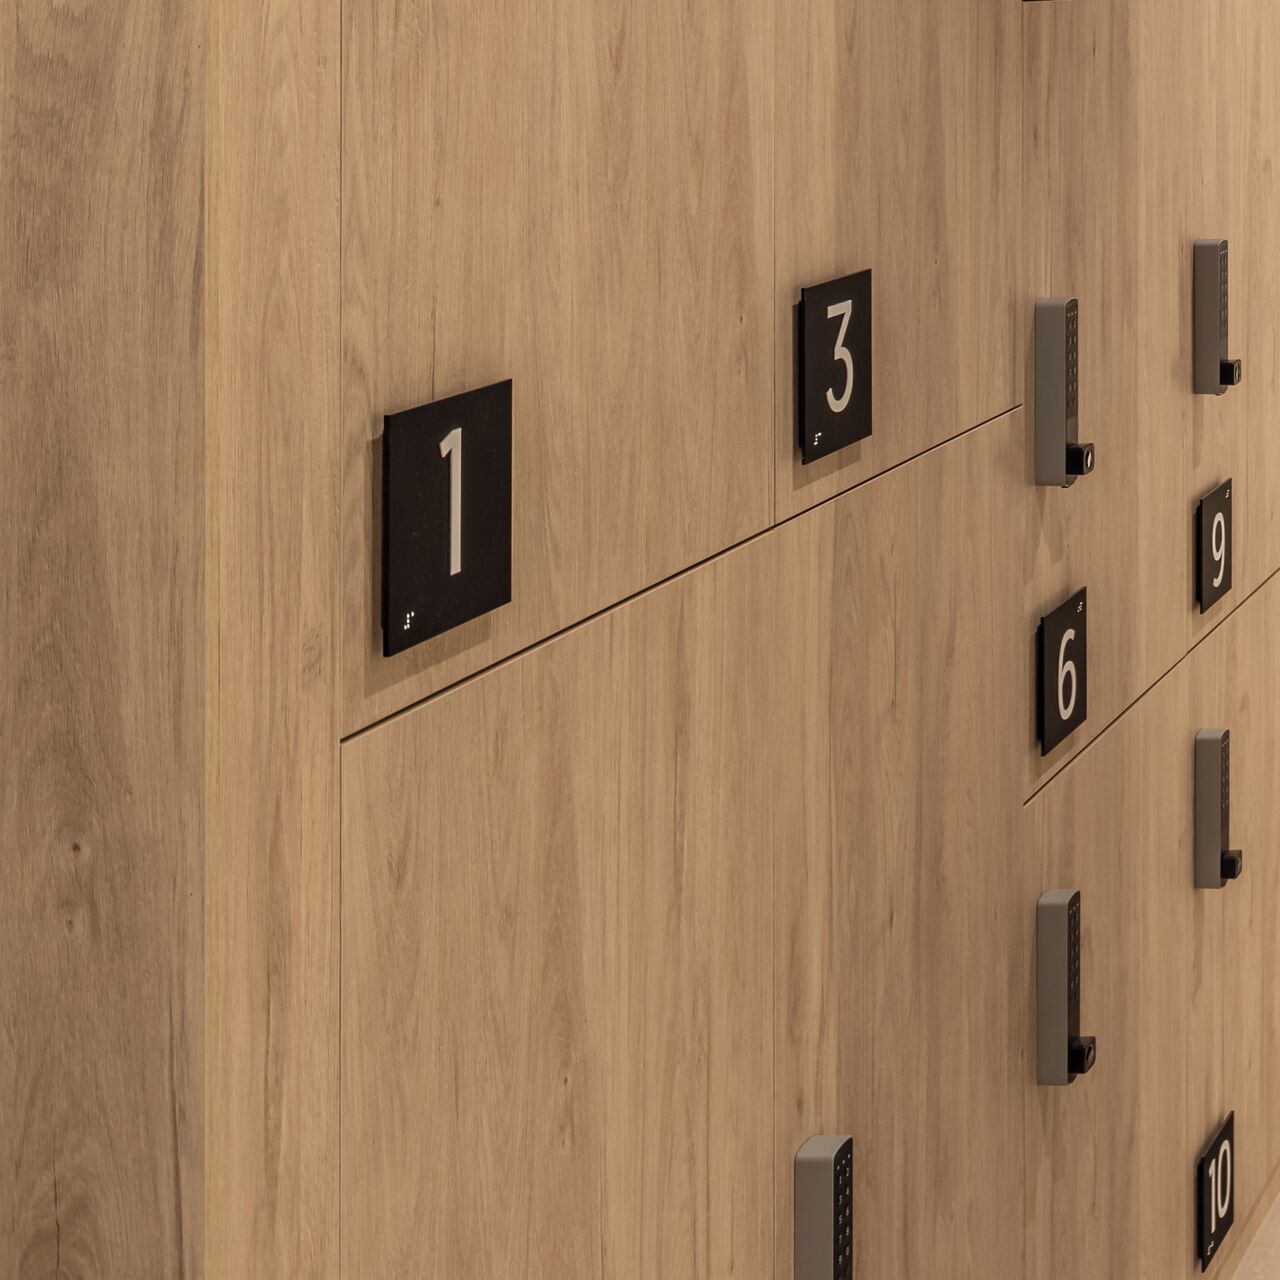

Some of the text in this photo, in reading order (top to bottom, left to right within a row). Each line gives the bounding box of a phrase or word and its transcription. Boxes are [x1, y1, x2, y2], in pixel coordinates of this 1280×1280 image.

[826, 299, 854, 413] 3
[439, 427, 462, 576] 1
[1211, 511, 1227, 588] 9
[1057, 628, 1077, 721] 6
[1208, 1139, 1231, 1234] 10
